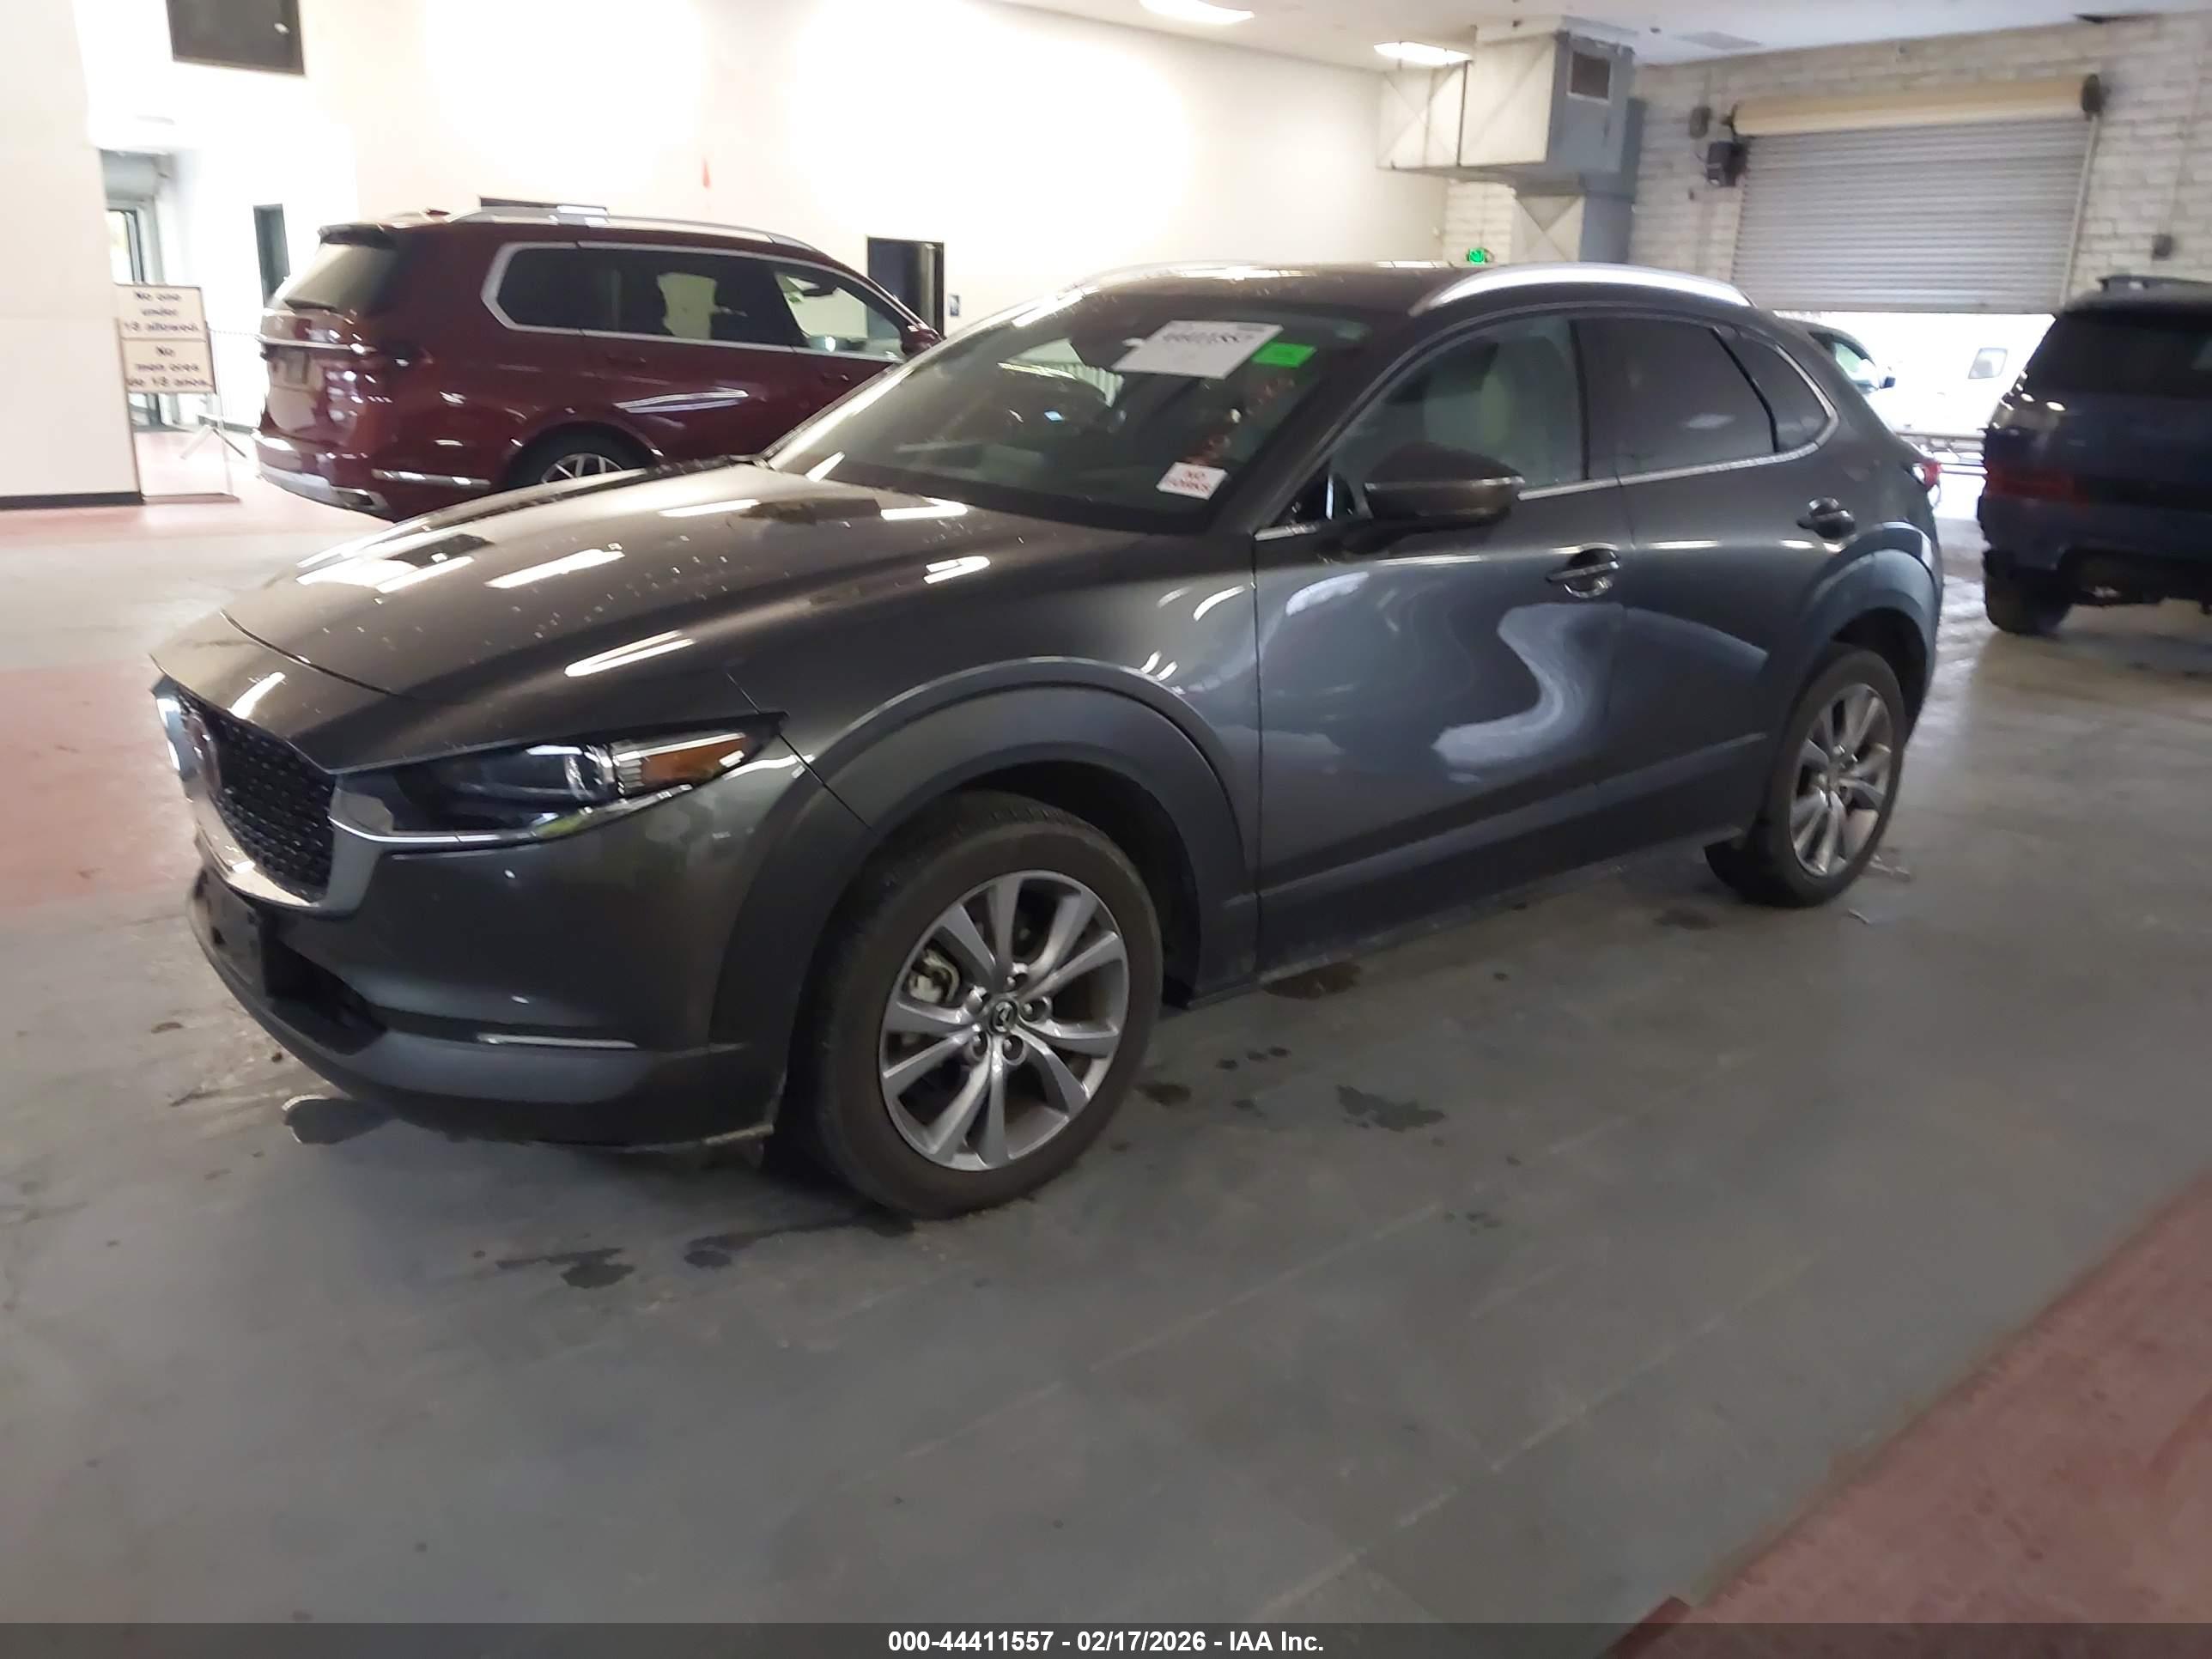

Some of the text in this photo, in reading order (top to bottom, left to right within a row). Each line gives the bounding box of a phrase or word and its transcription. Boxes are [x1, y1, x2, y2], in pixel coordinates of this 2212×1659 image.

[135, 291, 151, 301] No
[141, 307, 178, 316] under
[156, 346, 175, 356] No
